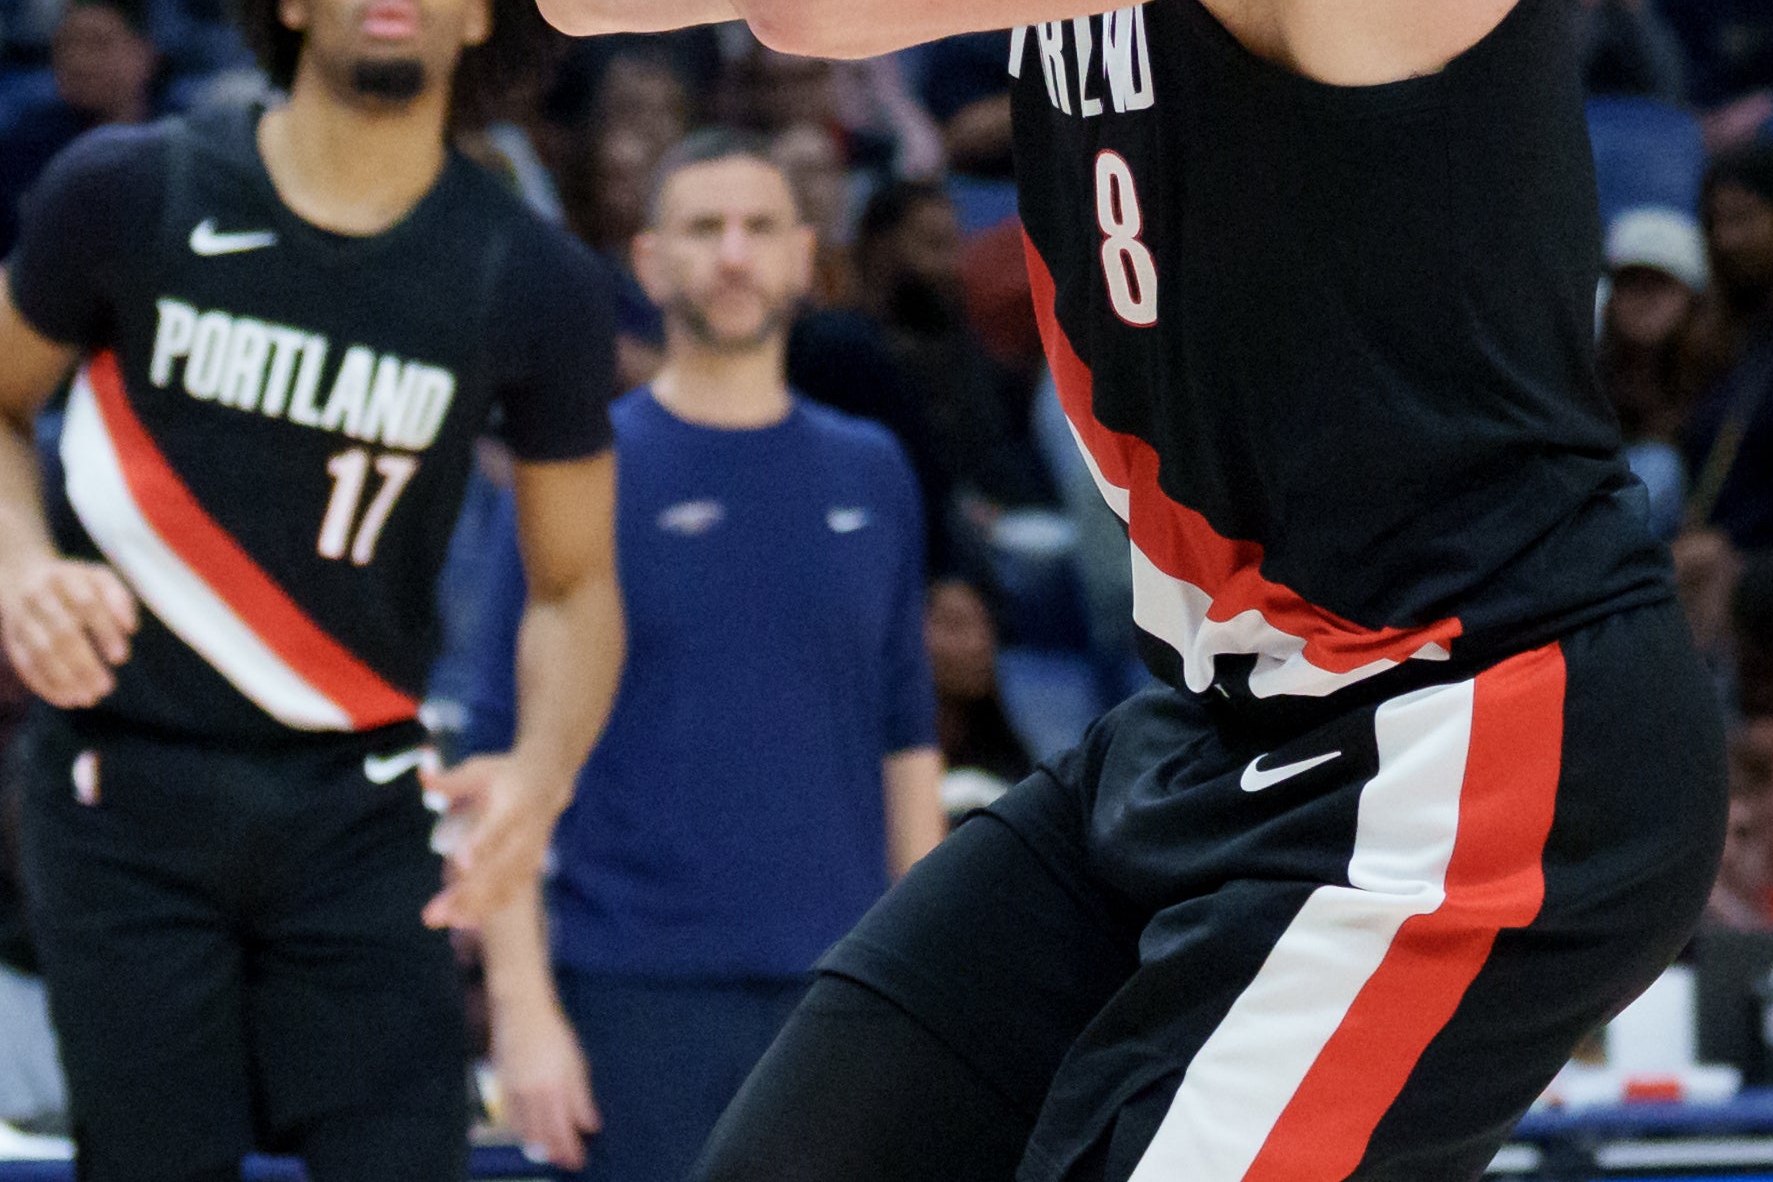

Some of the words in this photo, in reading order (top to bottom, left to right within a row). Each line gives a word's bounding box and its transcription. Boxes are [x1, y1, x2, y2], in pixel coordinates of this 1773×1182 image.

[1095, 147, 1159, 329] 8
[150, 296, 457, 452] PORTLAND
[317, 447, 421, 567] 17
